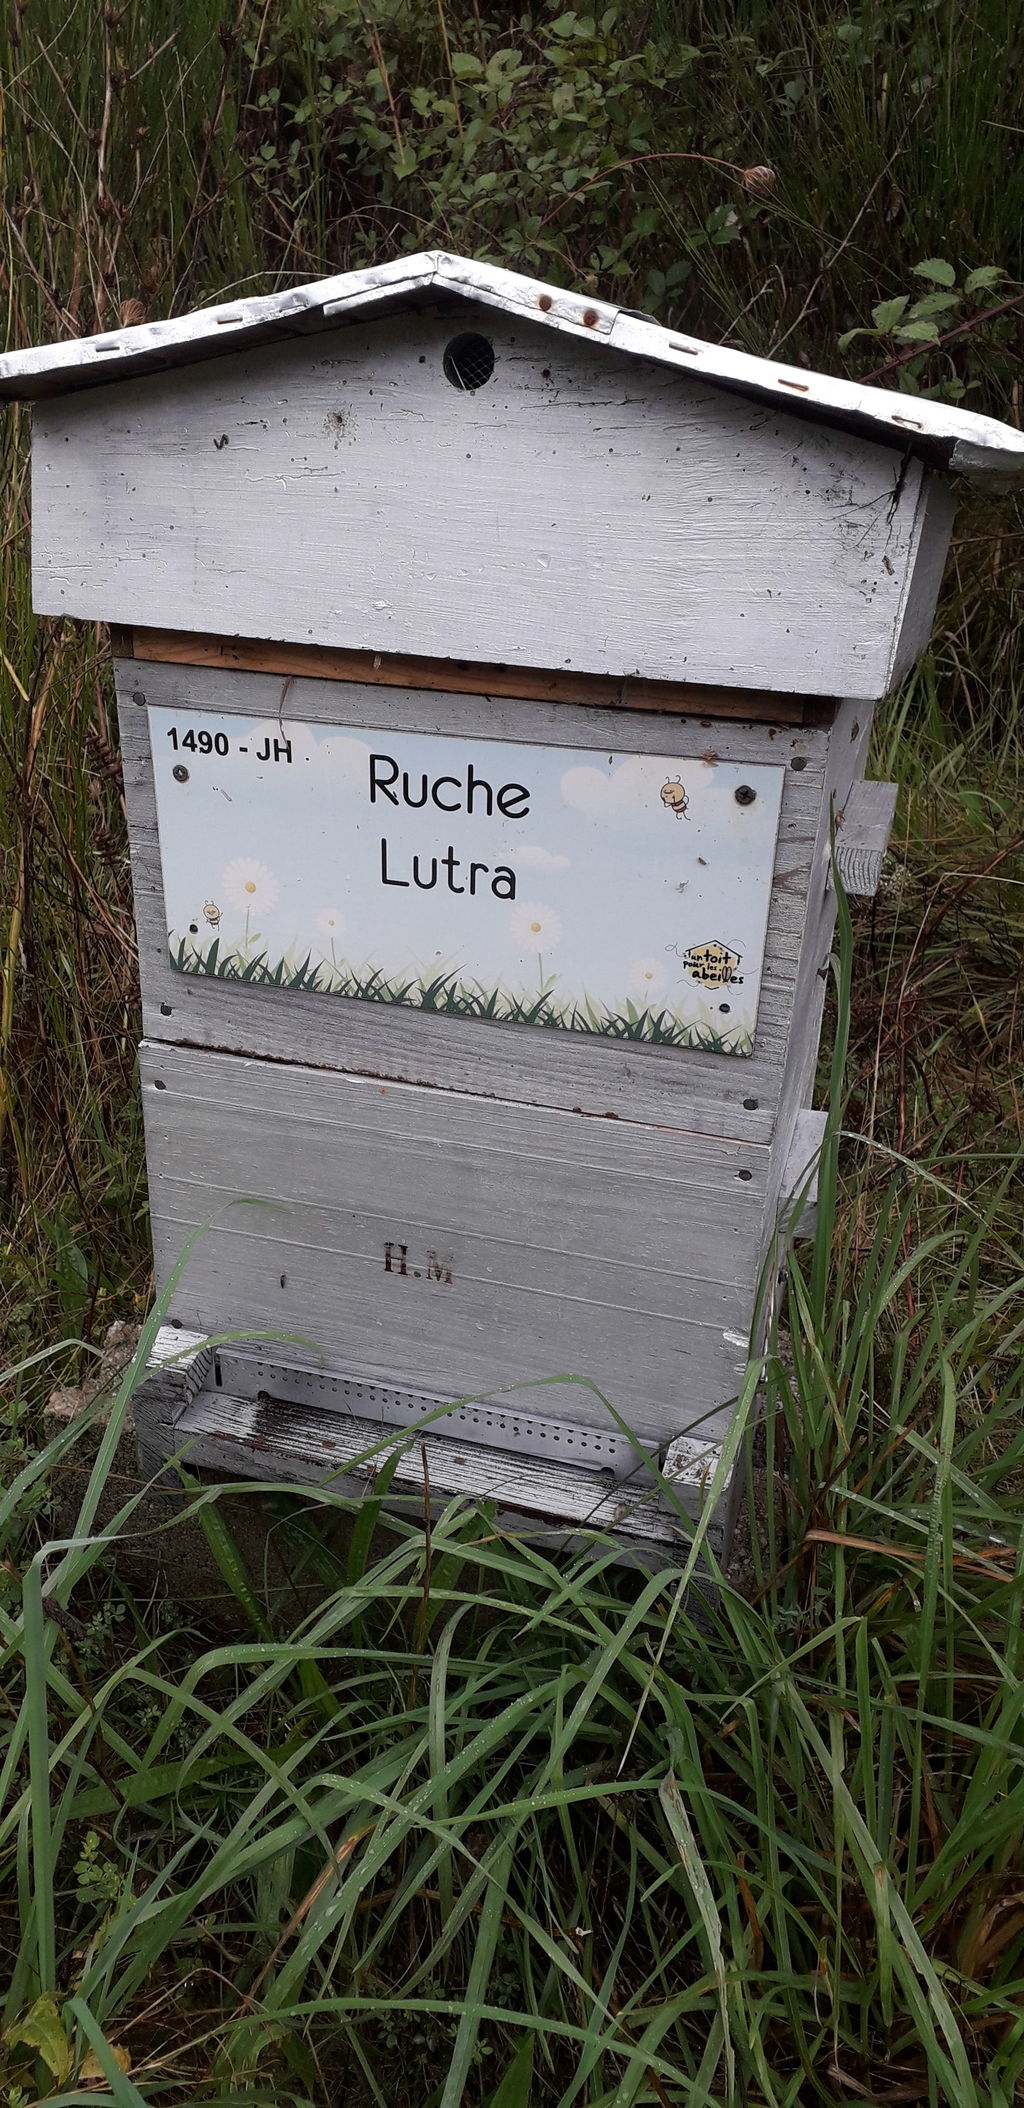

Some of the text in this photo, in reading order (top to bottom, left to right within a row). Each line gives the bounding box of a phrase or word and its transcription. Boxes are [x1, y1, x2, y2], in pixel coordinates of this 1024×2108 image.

[167, 727, 229, 756] 1490
[256, 737, 292, 763] JH
[369, 754, 531, 819] Ruche
[381, 837, 516, 900] Lutra
[682, 960, 718, 971] pour les
[703, 949, 732, 965] toit
[691, 966, 745, 985] abeilles
